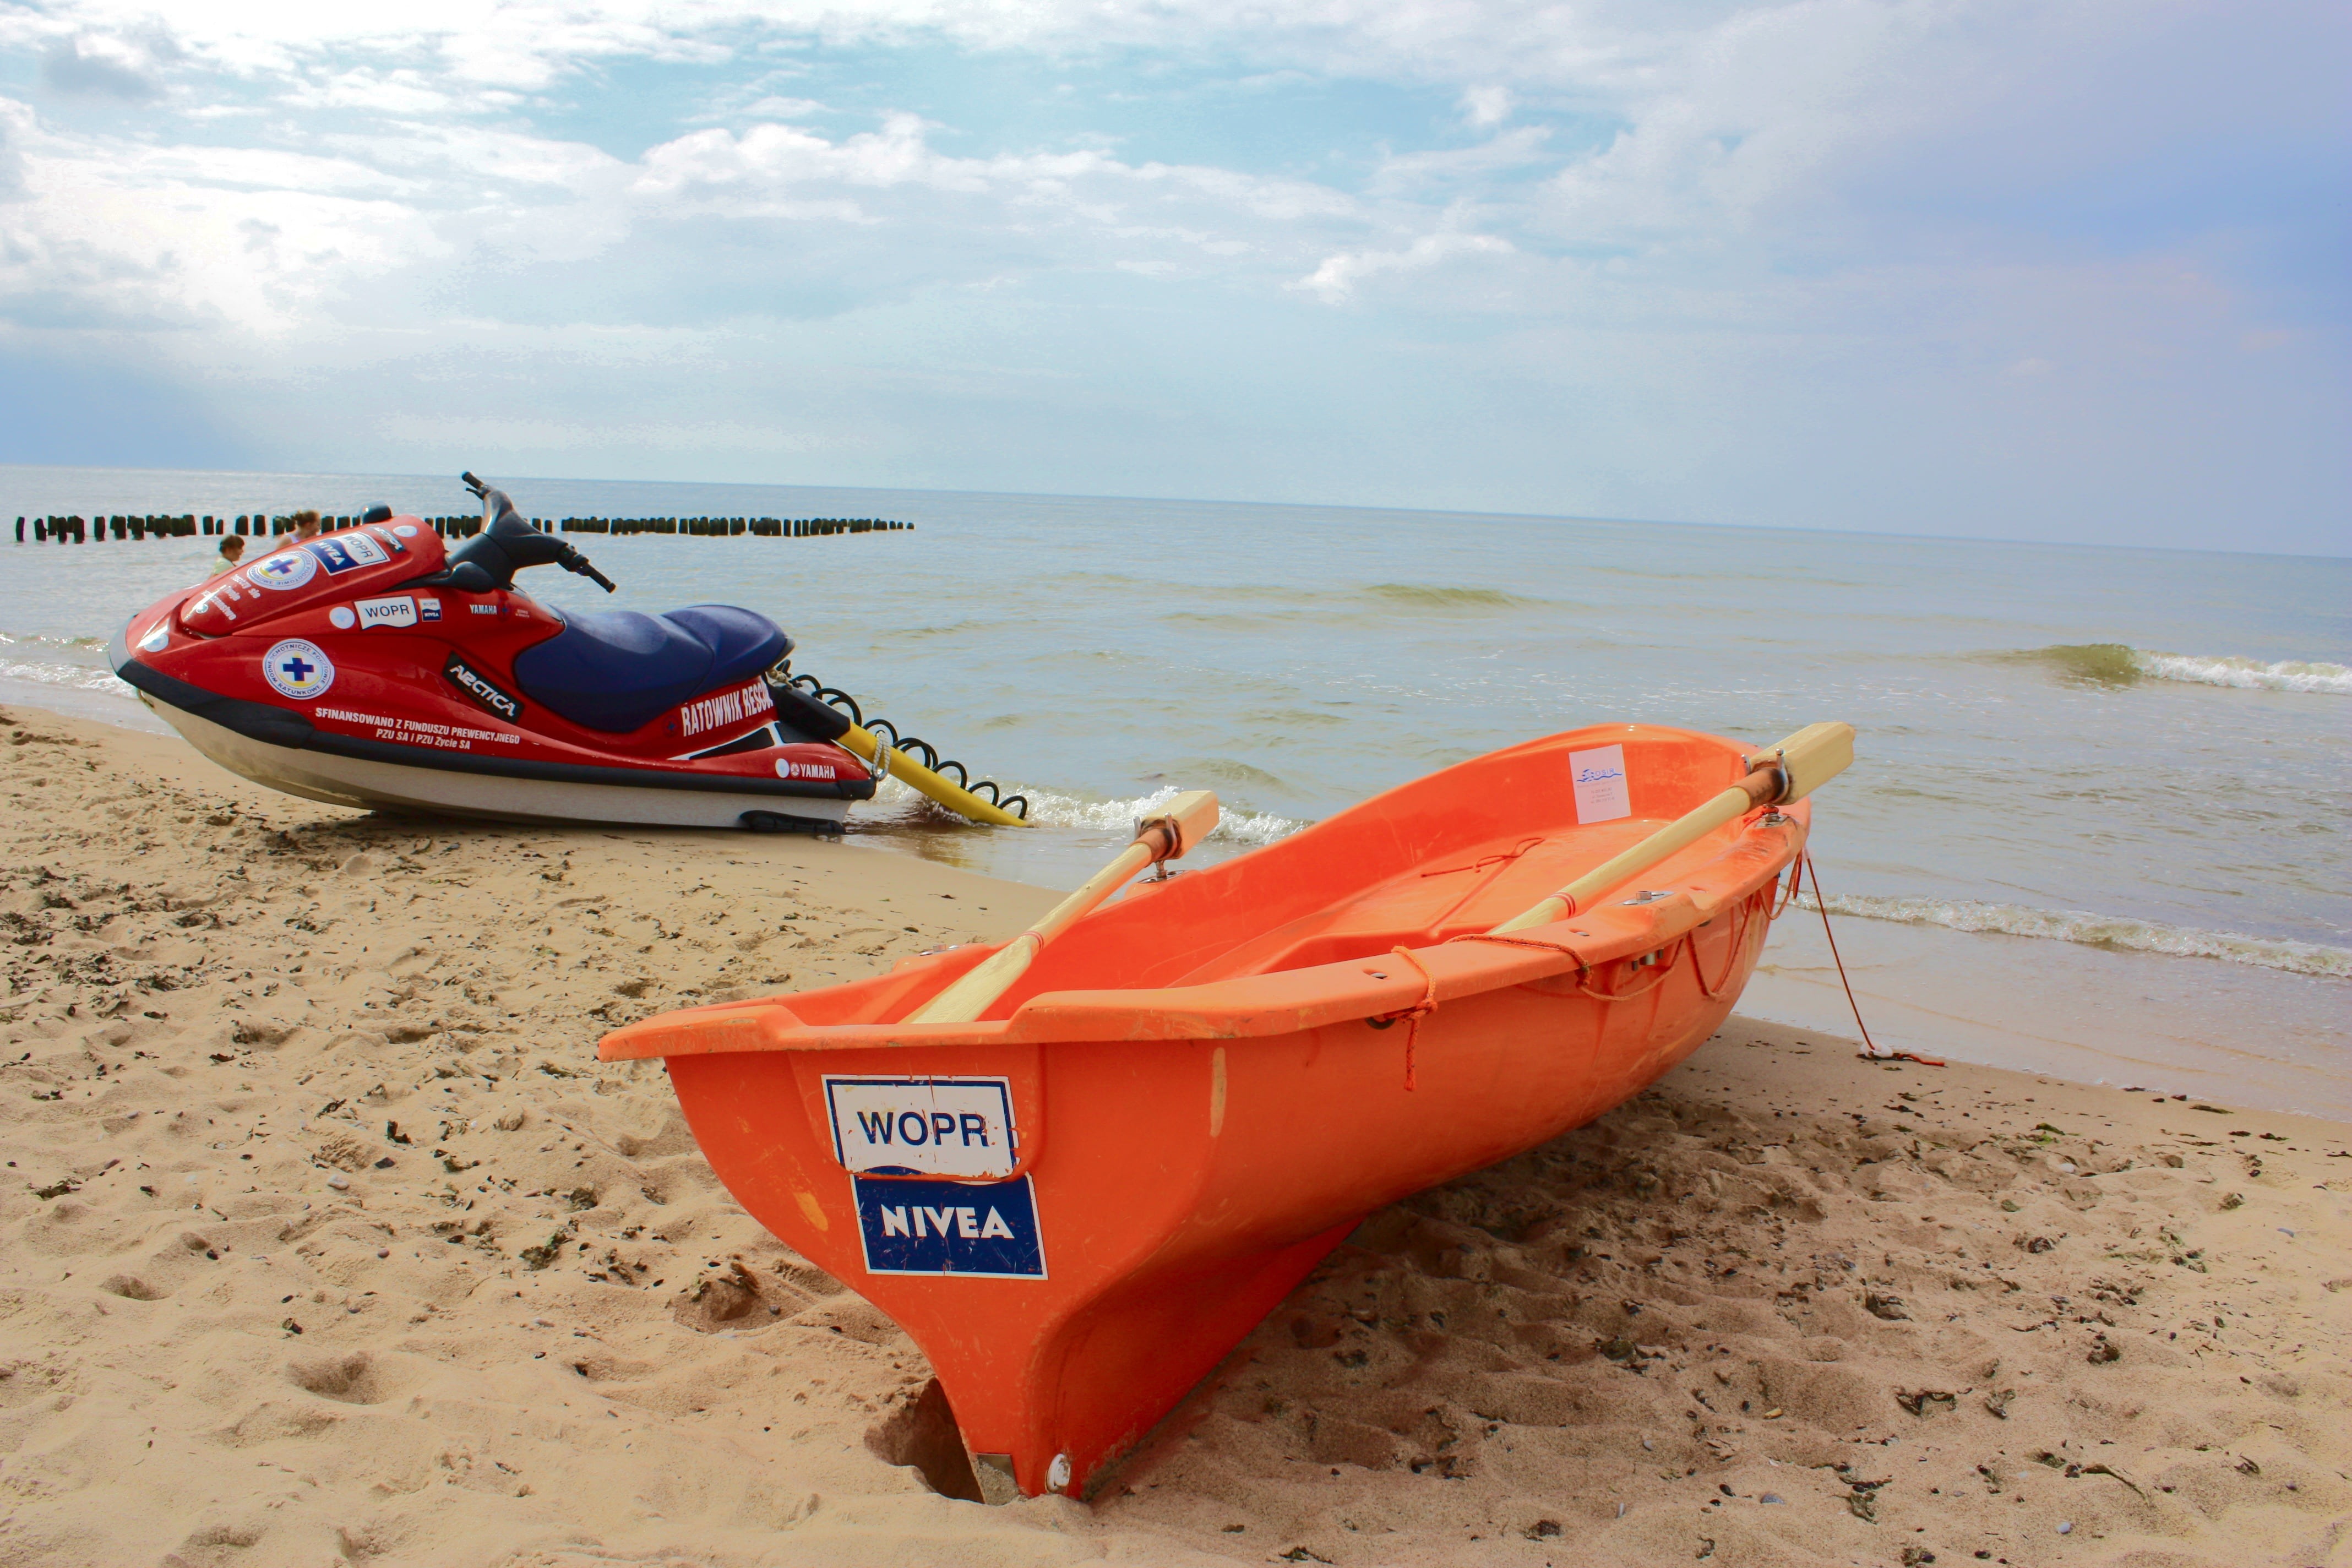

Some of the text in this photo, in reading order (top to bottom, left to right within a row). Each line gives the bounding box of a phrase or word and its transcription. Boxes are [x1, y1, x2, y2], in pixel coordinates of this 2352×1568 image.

[315, 541, 345, 565] NIVEA
[344, 535, 373, 558] WOPR
[364, 604, 410, 618] WOPR
[469, 604, 497, 615] YAMAHA
[449, 665, 516, 717] ARCTICA
[315, 707, 521, 744] SFINANSOWANO Z FUNDUSZU PREWENCYJNEGO
[680, 690, 743, 737] RATOWNIK
[375, 728, 395, 739] PZU
[396, 731, 409, 742] SA
[410, 733, 415, 742] i
[415, 733, 434, 744] PZU
[459, 739, 471, 749] SA
[800, 763, 836, 779] YAMAHA
[857, 1111, 989, 1147] WOPR
[881, 1204, 1015, 1239] NIVEA
